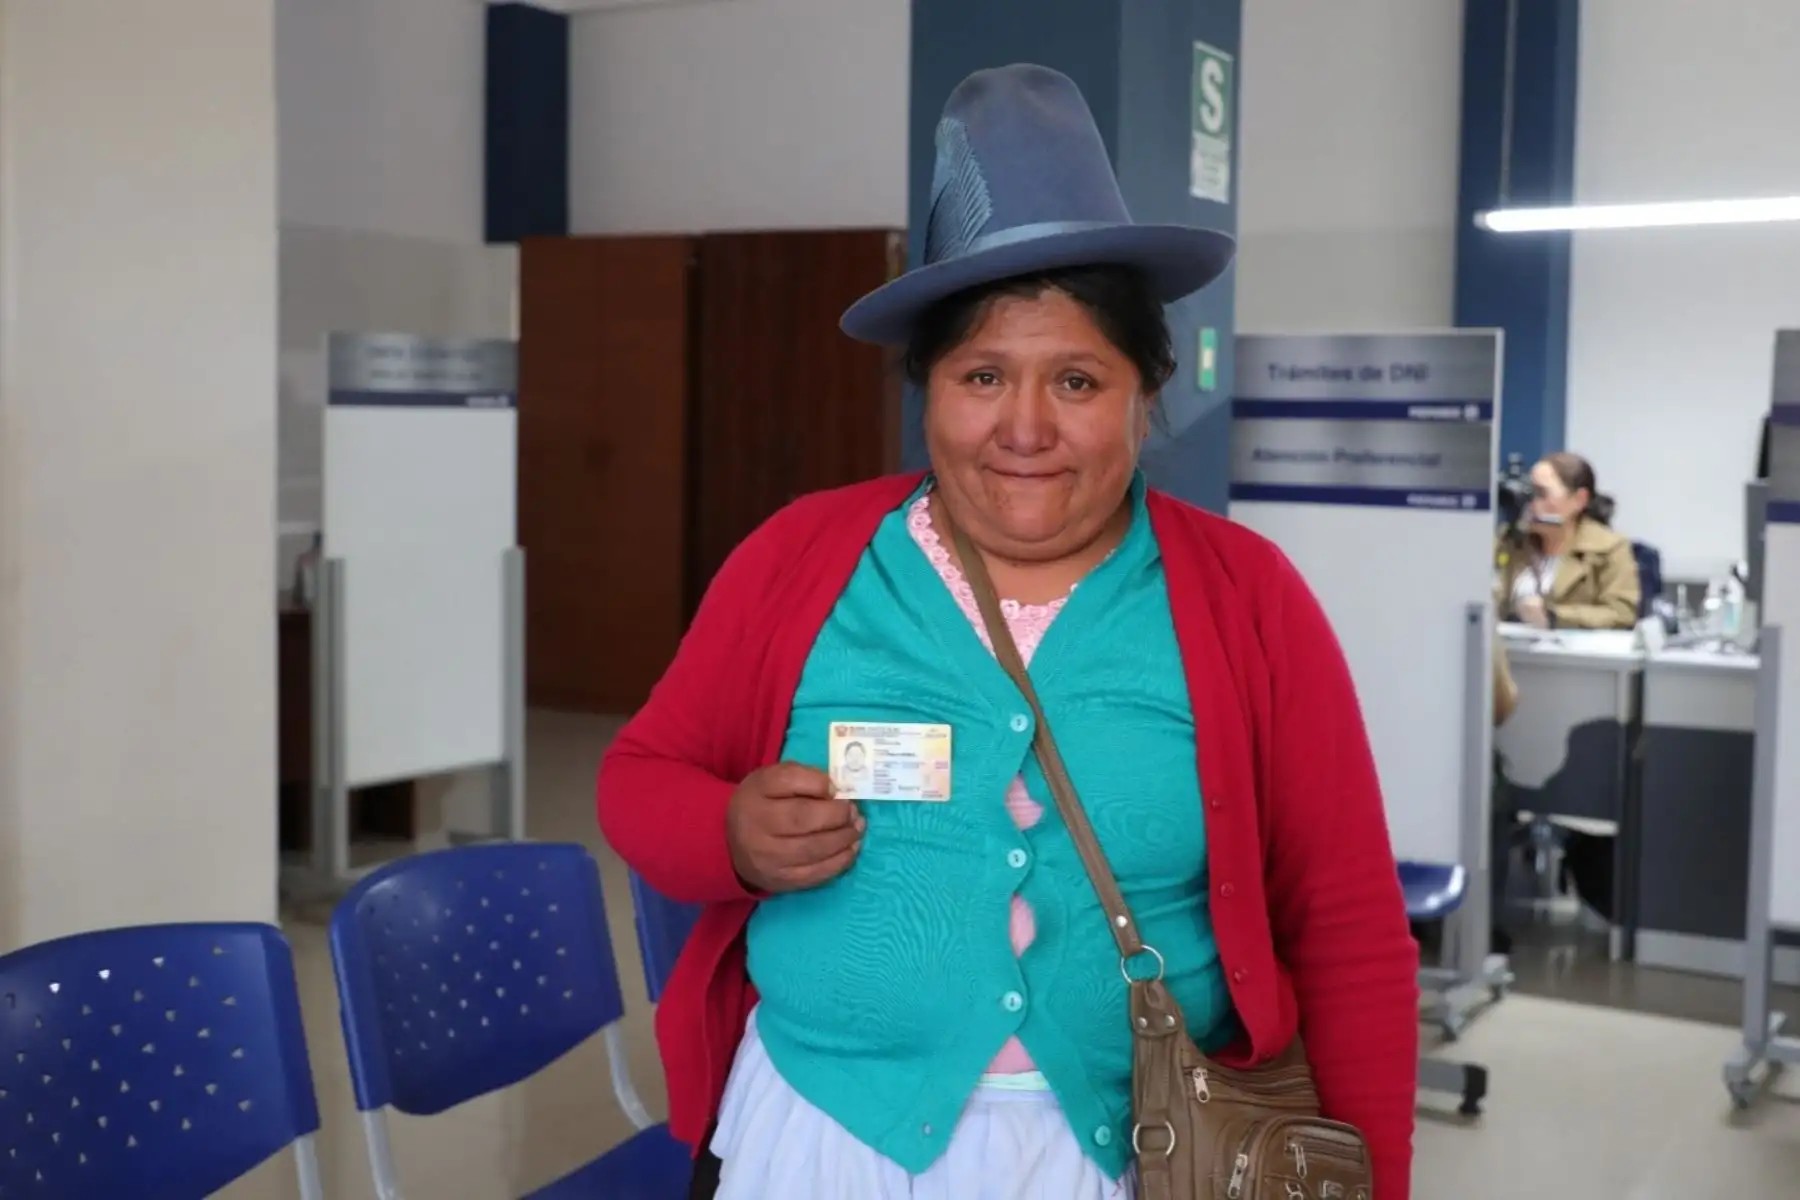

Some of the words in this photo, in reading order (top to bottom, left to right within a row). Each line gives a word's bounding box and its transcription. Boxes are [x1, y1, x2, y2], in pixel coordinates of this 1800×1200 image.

[1200, 56, 1225, 134] S
[1358, 364, 1383, 381] de
[1389, 362, 1430, 382] DNI
